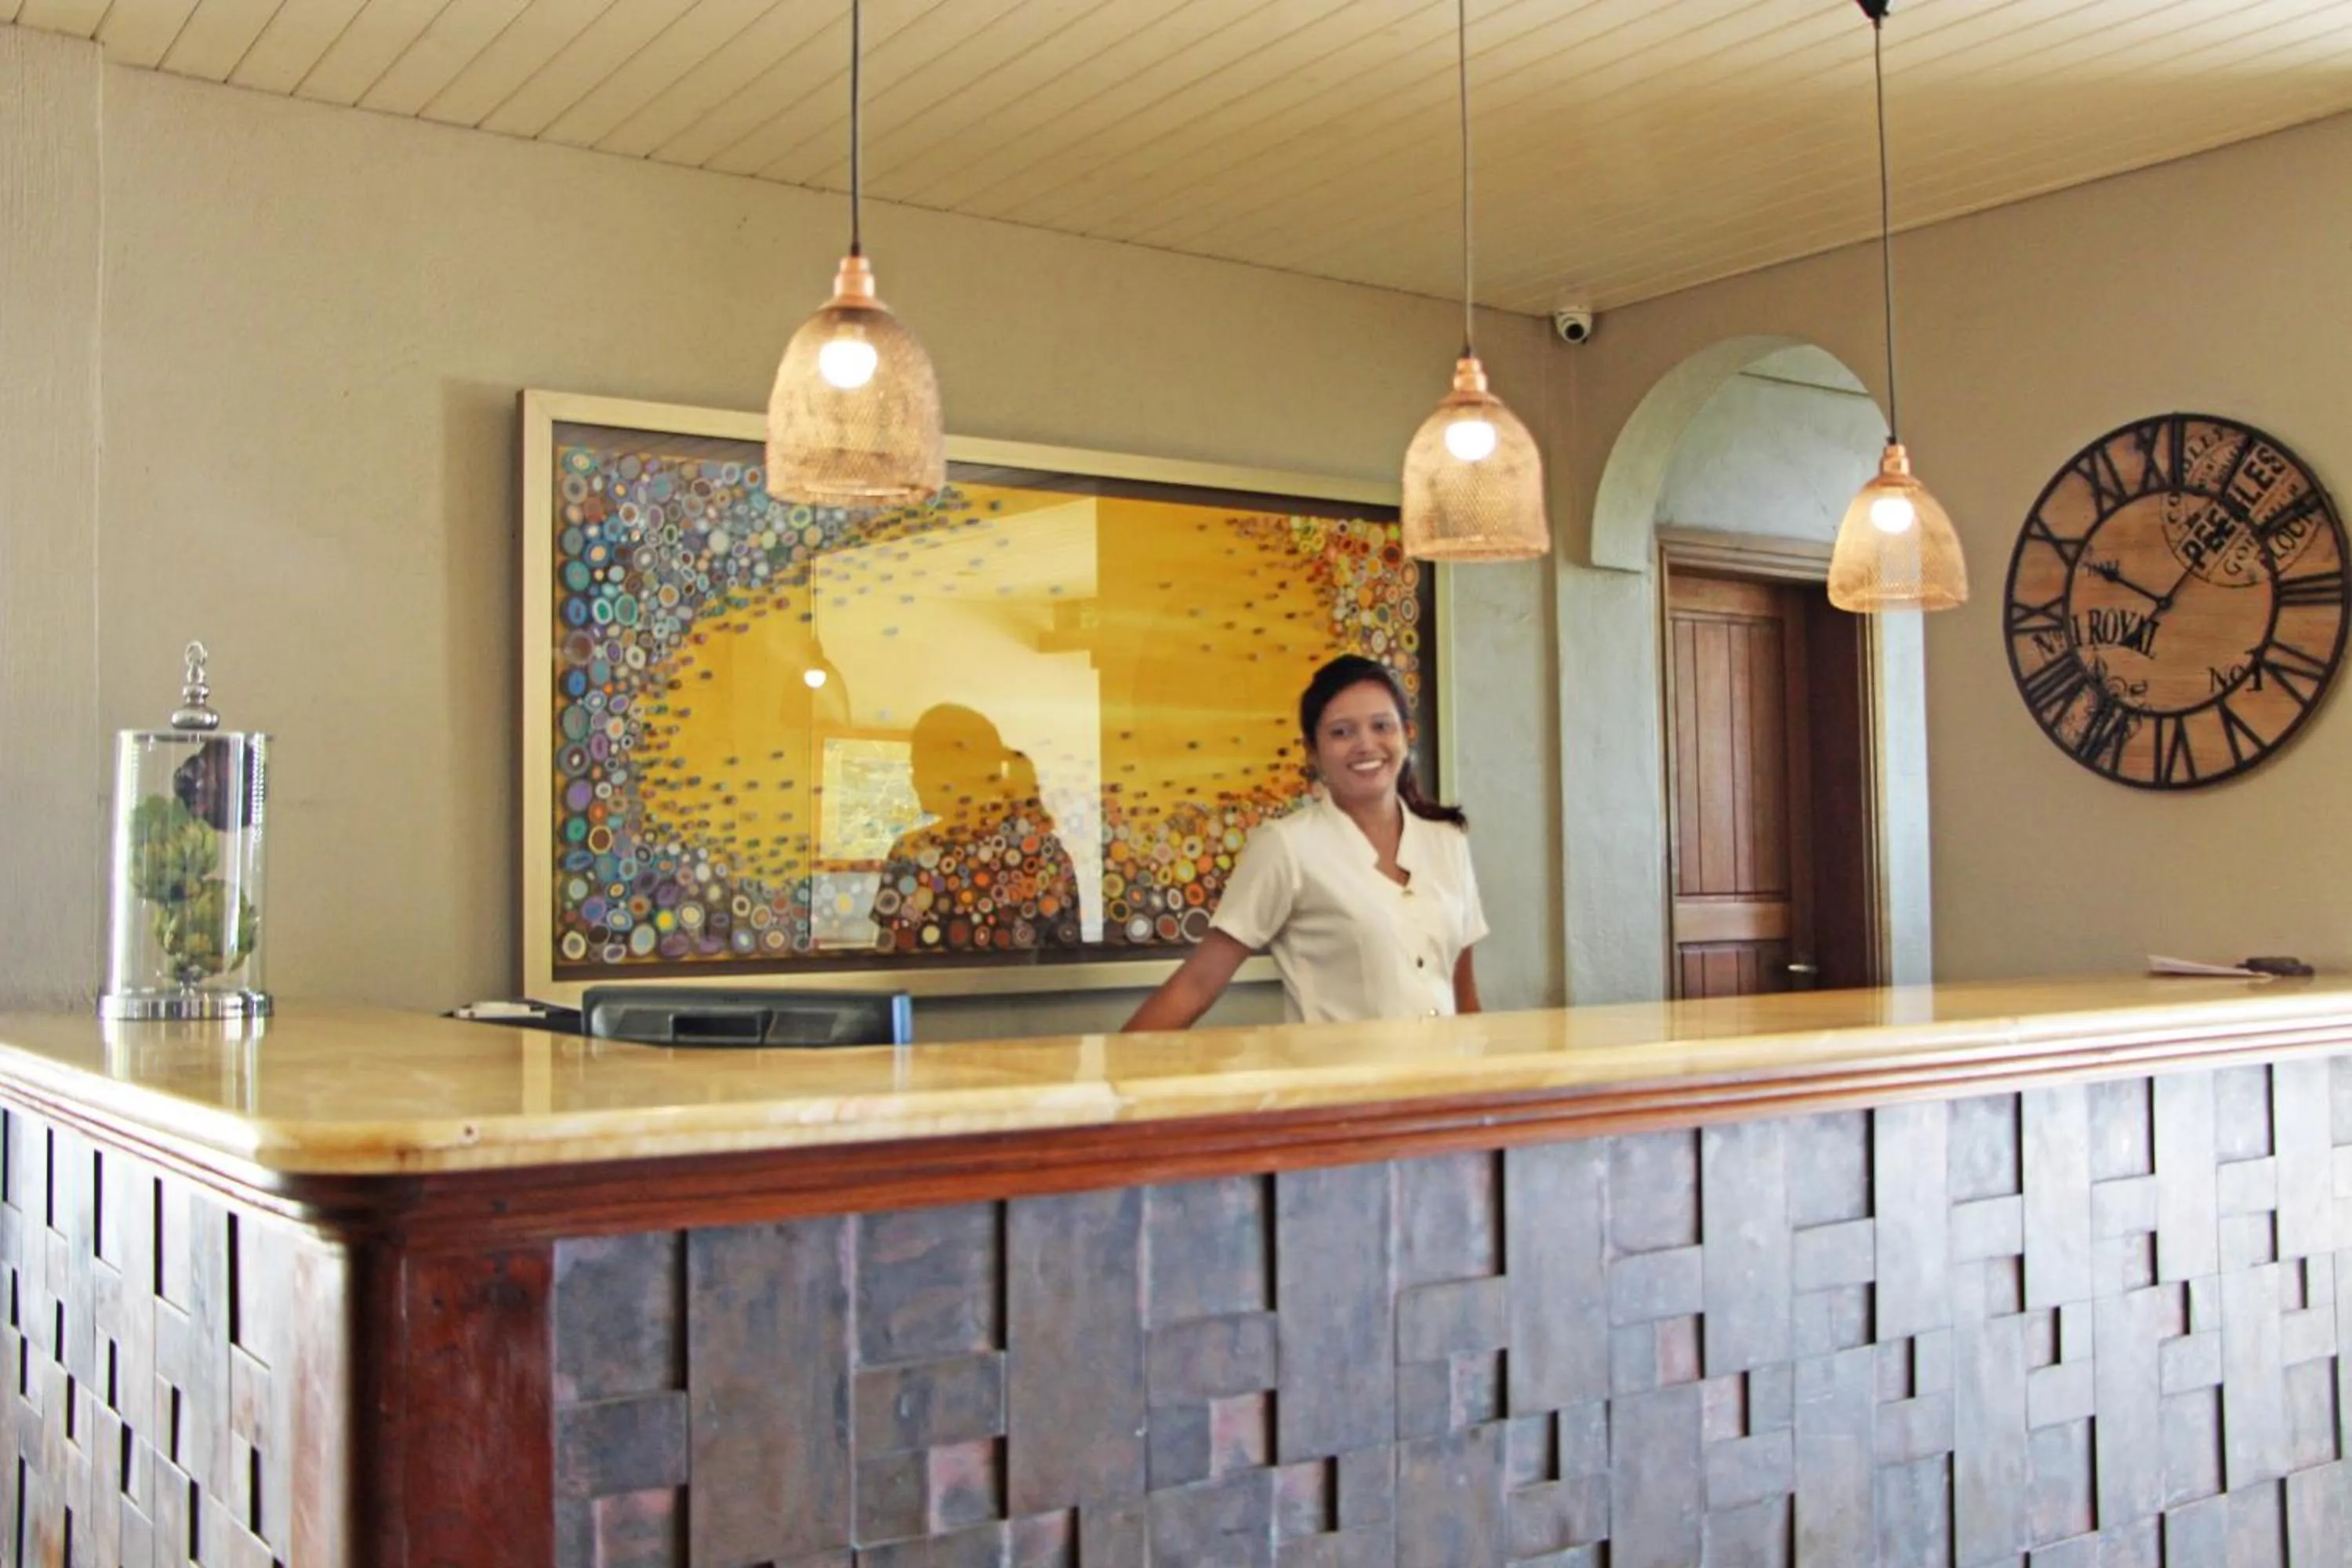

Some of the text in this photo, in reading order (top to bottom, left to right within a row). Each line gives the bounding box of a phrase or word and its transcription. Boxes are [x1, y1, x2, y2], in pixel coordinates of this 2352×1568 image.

[2025, 515, 2085, 566] X
[2276, 571, 2344, 607] III
[2088, 608, 2161, 660] ROYAL
